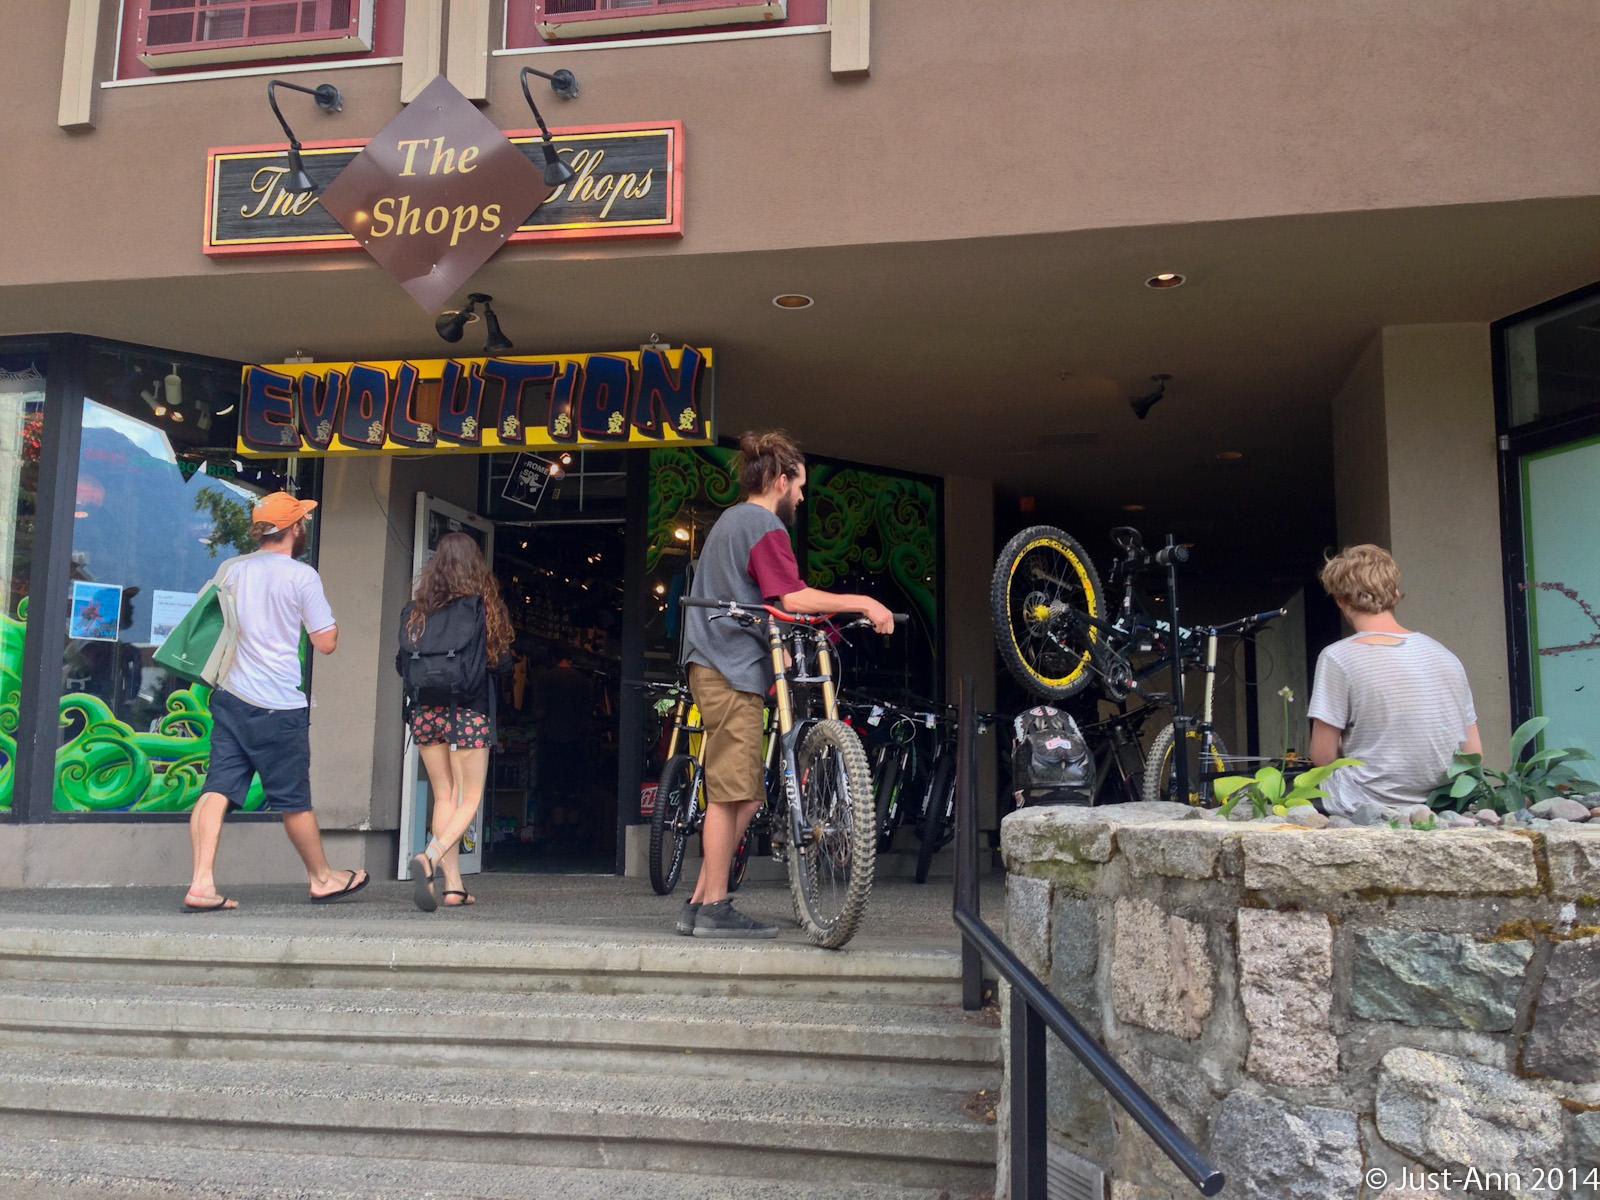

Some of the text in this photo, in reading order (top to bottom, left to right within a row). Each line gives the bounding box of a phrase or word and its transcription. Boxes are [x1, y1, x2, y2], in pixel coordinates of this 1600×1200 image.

[396, 136, 480, 177] The
[543, 147, 654, 219] hops
[370, 196, 502, 247] Shops
[244, 344, 702, 449] EVOLUTION
